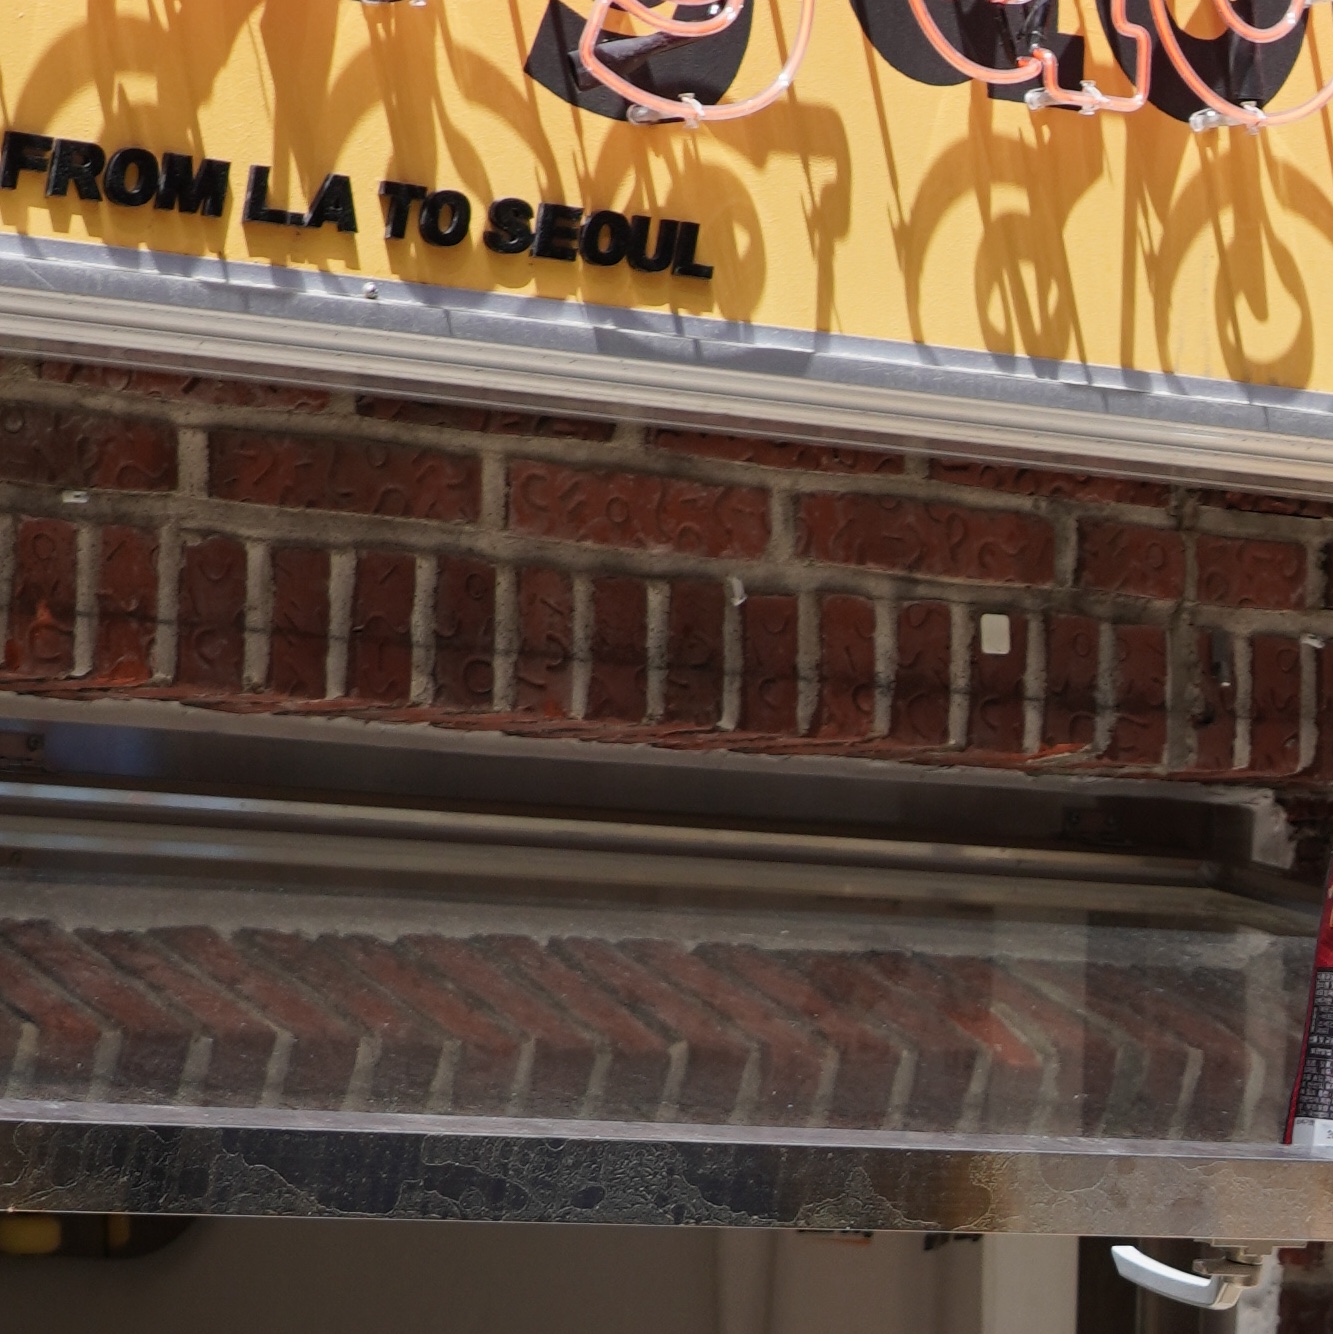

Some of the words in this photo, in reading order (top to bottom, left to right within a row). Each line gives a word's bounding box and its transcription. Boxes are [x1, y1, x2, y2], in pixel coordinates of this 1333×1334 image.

[2, 131, 231, 218] FROM
[242, 165, 358, 235] L.A
[379, 180, 471, 248] TO
[483, 196, 715, 281] SEOUL
